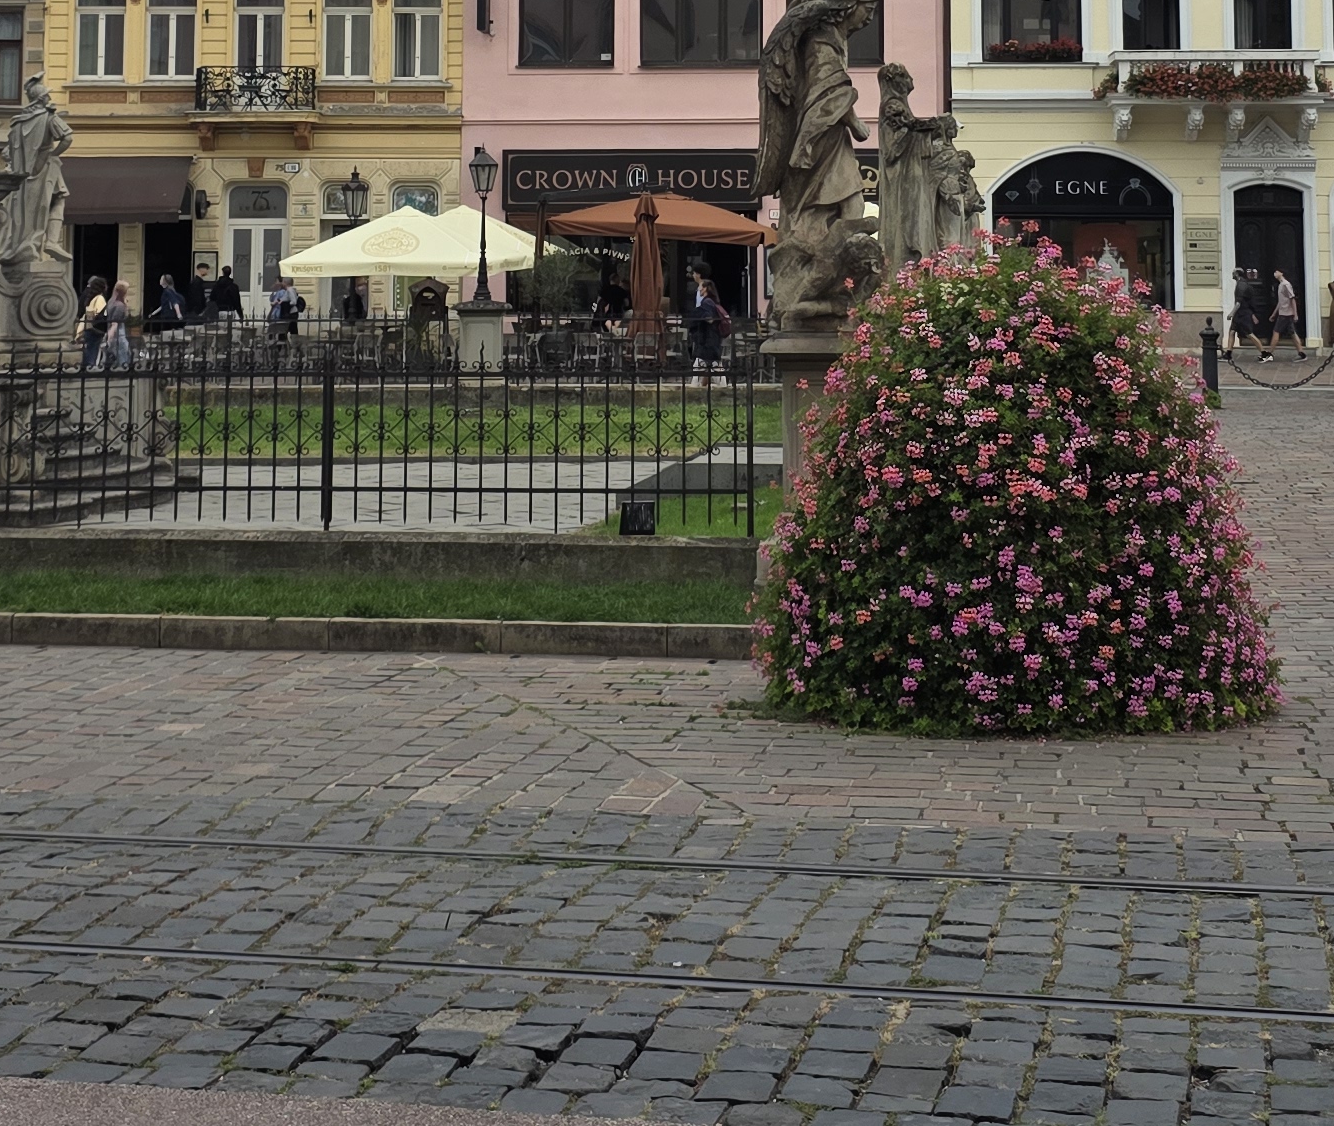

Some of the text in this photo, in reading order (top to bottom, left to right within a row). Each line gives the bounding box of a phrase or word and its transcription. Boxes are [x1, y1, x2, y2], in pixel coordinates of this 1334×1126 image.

[515, 169, 617, 190] CROWN
[656, 169, 751, 189] HOUSE
[1055, 180, 1109, 195] EGNE
